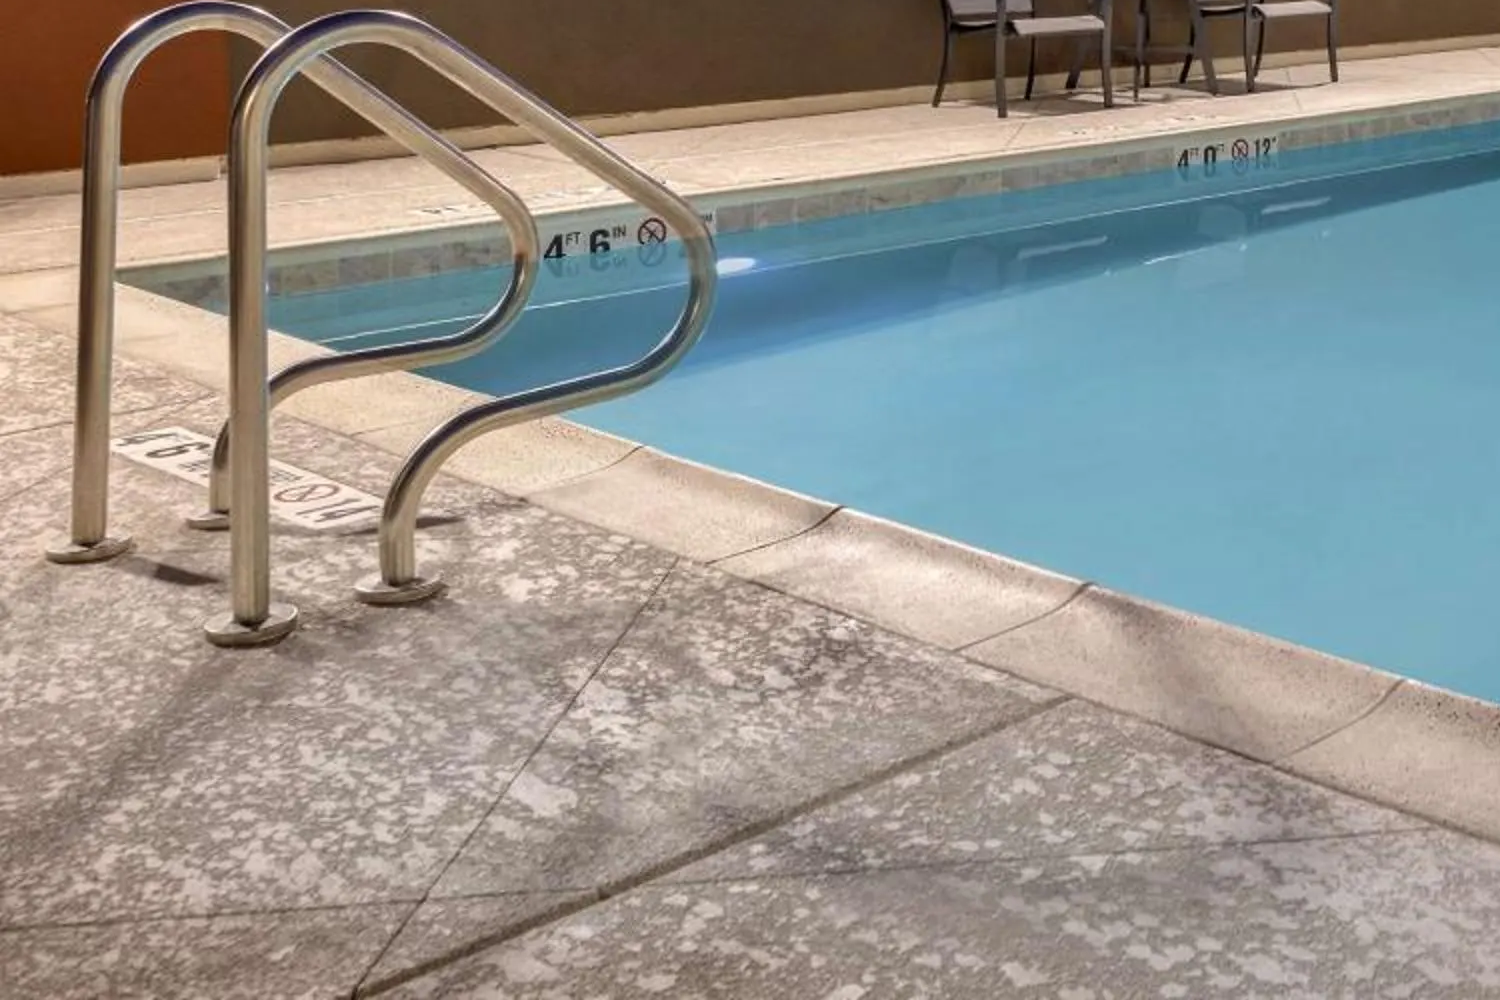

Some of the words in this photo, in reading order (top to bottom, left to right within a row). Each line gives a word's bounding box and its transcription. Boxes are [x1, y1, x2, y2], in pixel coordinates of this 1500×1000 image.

[543, 233, 567, 259] 4
[565, 230, 581, 246] FT
[589, 228, 611, 254] 6
[612, 223, 627, 238] IN
